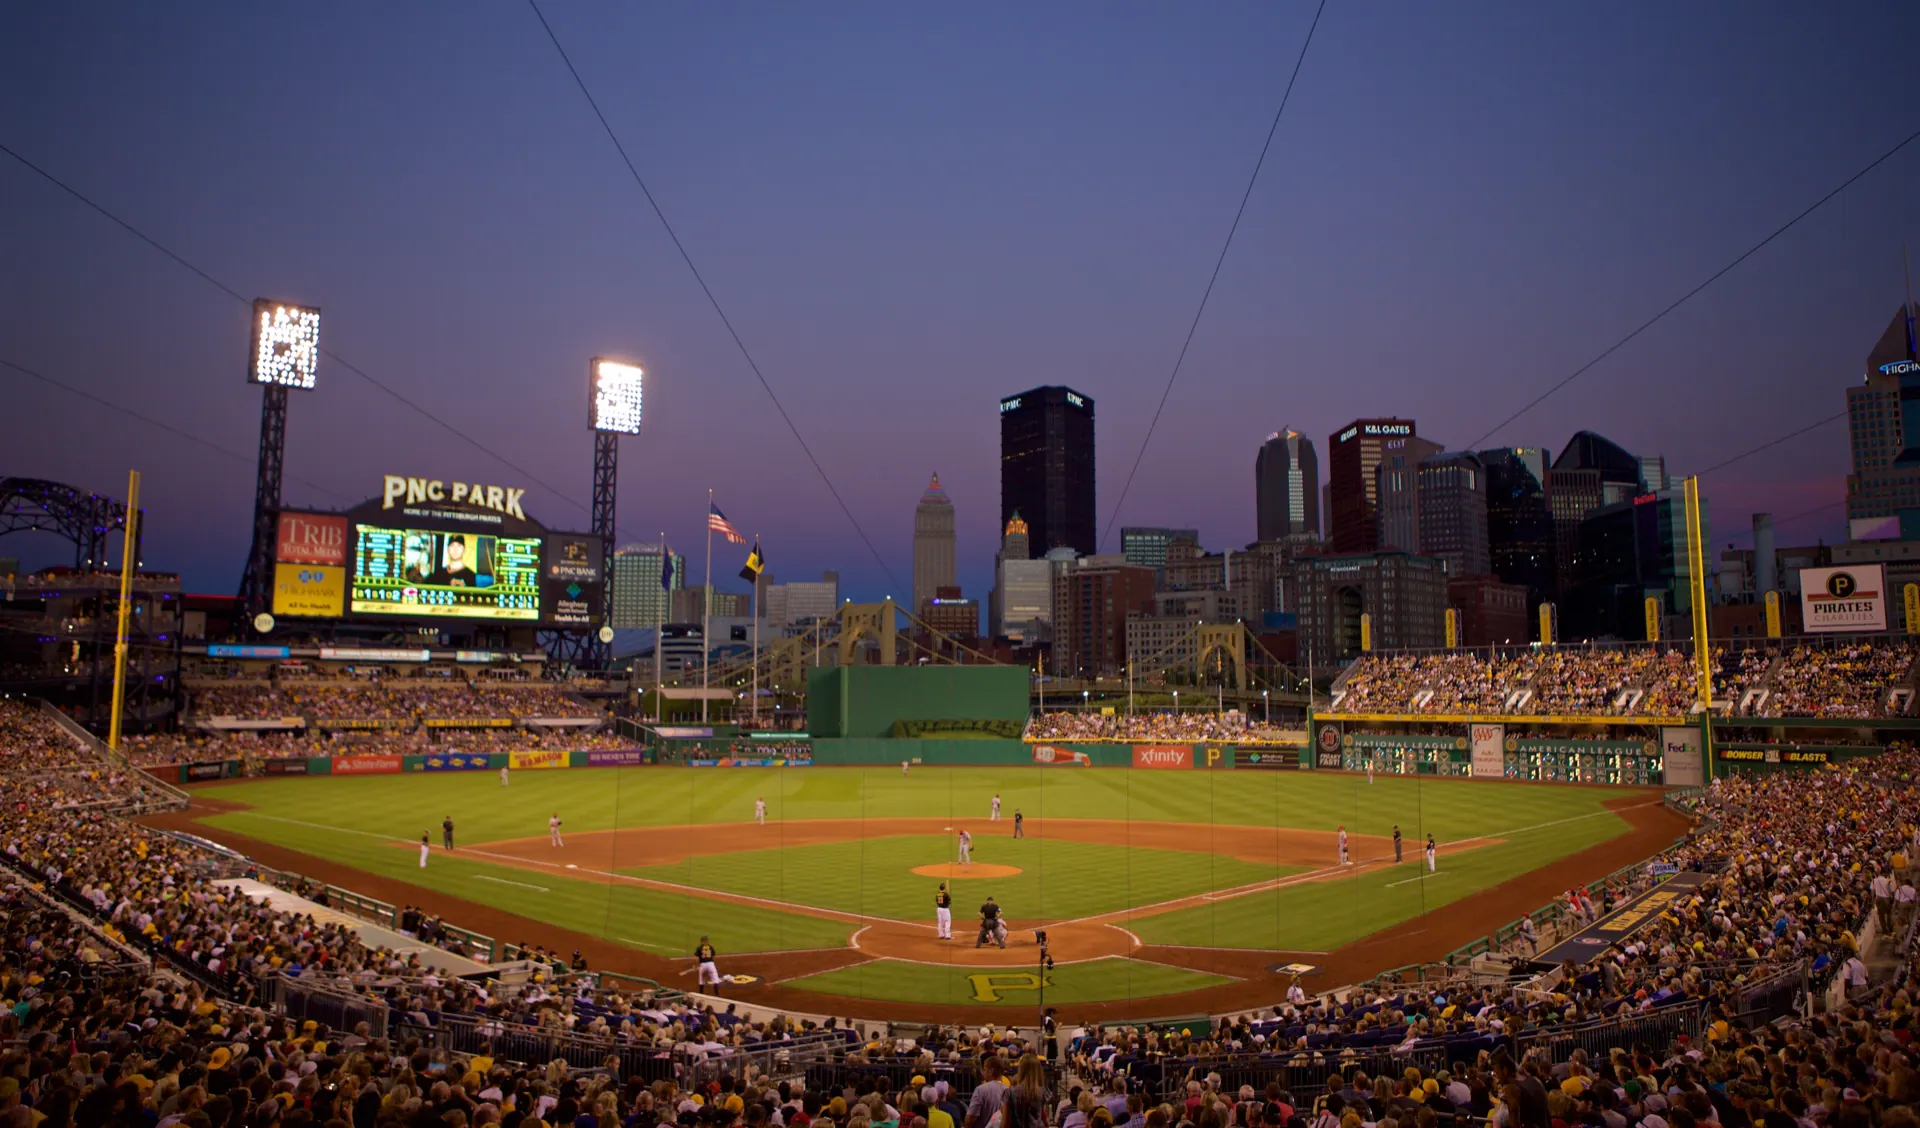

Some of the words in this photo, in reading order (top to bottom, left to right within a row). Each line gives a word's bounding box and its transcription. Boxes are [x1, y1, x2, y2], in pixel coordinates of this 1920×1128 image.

[1000, 398, 1021, 412] UPMC
[1067, 392, 1083, 407] UPMC
[1365, 425, 1381, 433] K&L
[1382, 425, 1410, 434] GATES
[382, 474, 445, 510] PNC
[451, 481, 526, 521] PARK
[284, 518, 342, 545] TRIB
[283, 543, 310, 554] TOTAL
[314, 545, 342, 557] MEDIA
[506, 543, 514, 553] 0
[525, 545, 531, 554] 1
[560, 566, 576, 576] PNC
[577, 567, 596, 576] BANK
[1835, 578, 1848, 594] P
[1814, 602, 1872, 613] PIRATES
[1815, 613, 1874, 622] CHARITIES
[1355, 741, 1408, 749] NATIONAL
[1412, 742, 1454, 750] LEAGUE
[1520, 745, 1585, 754] AMERICAN
[1590, 747, 1641, 755] LEAGUE
[1668, 742, 1696, 752] FedEx
[1141, 748, 1184, 765] xfinity
[1207, 749, 1220, 766] P
[1726, 750, 1764, 759] BOWSER
[1790, 752, 1827, 761] BLASTS
[967, 972, 1053, 1002] P
